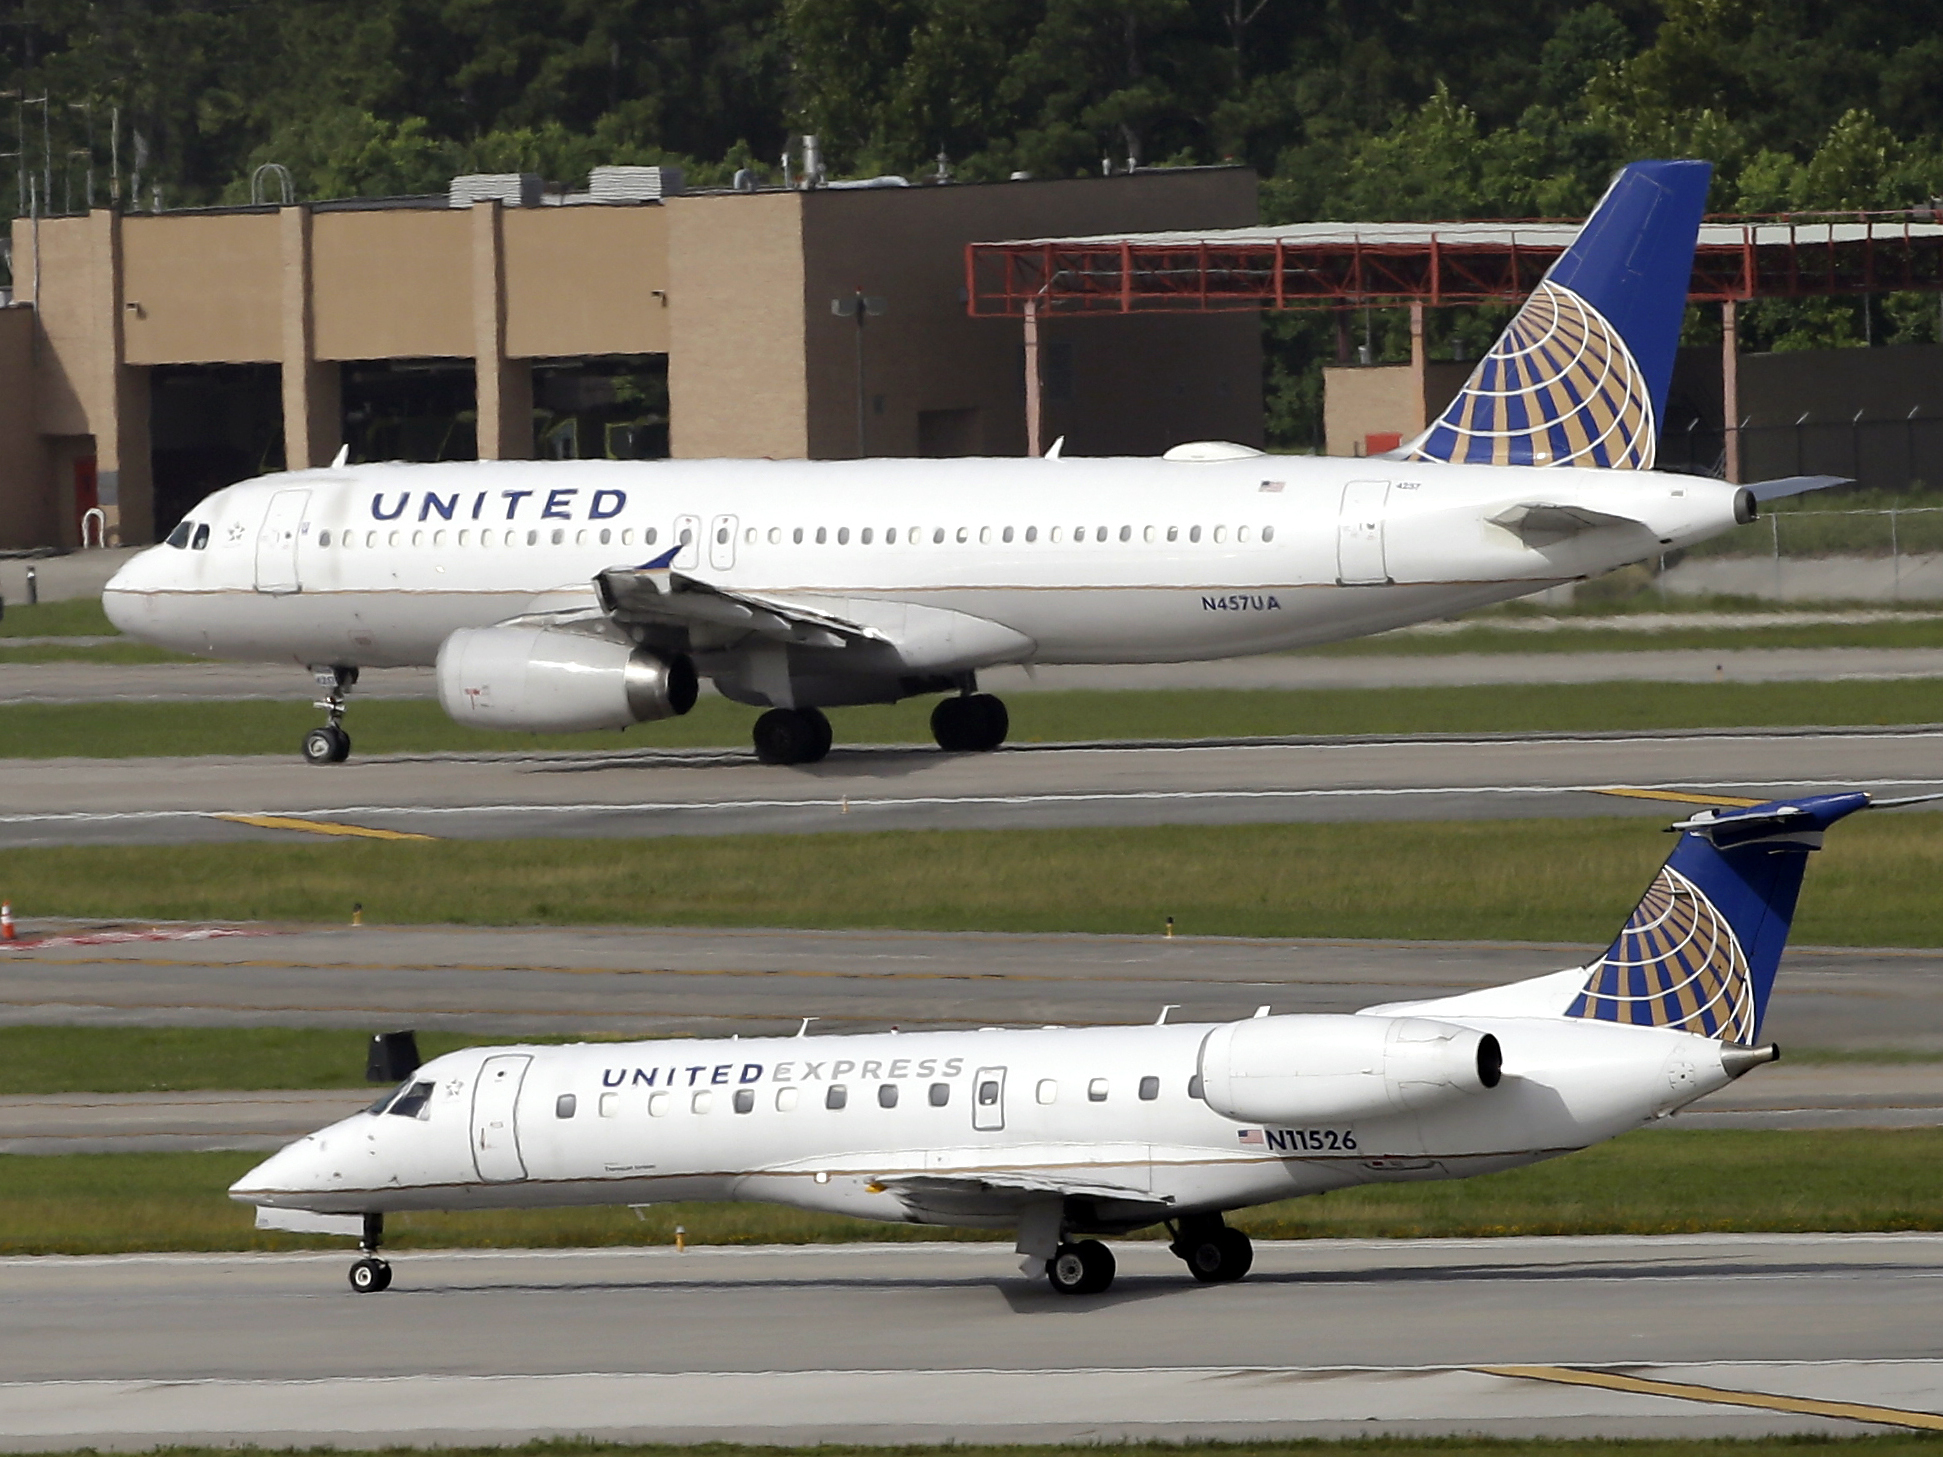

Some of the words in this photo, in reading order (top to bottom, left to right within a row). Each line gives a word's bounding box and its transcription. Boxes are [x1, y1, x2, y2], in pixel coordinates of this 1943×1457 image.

[371, 488, 627, 522] UNITED
[1201, 595, 1282, 611] N457UA
[602, 1063, 764, 1087] UNITED
[771, 1057, 965, 1083] EXPRESS
[1265, 1130, 1358, 1151] N11526
